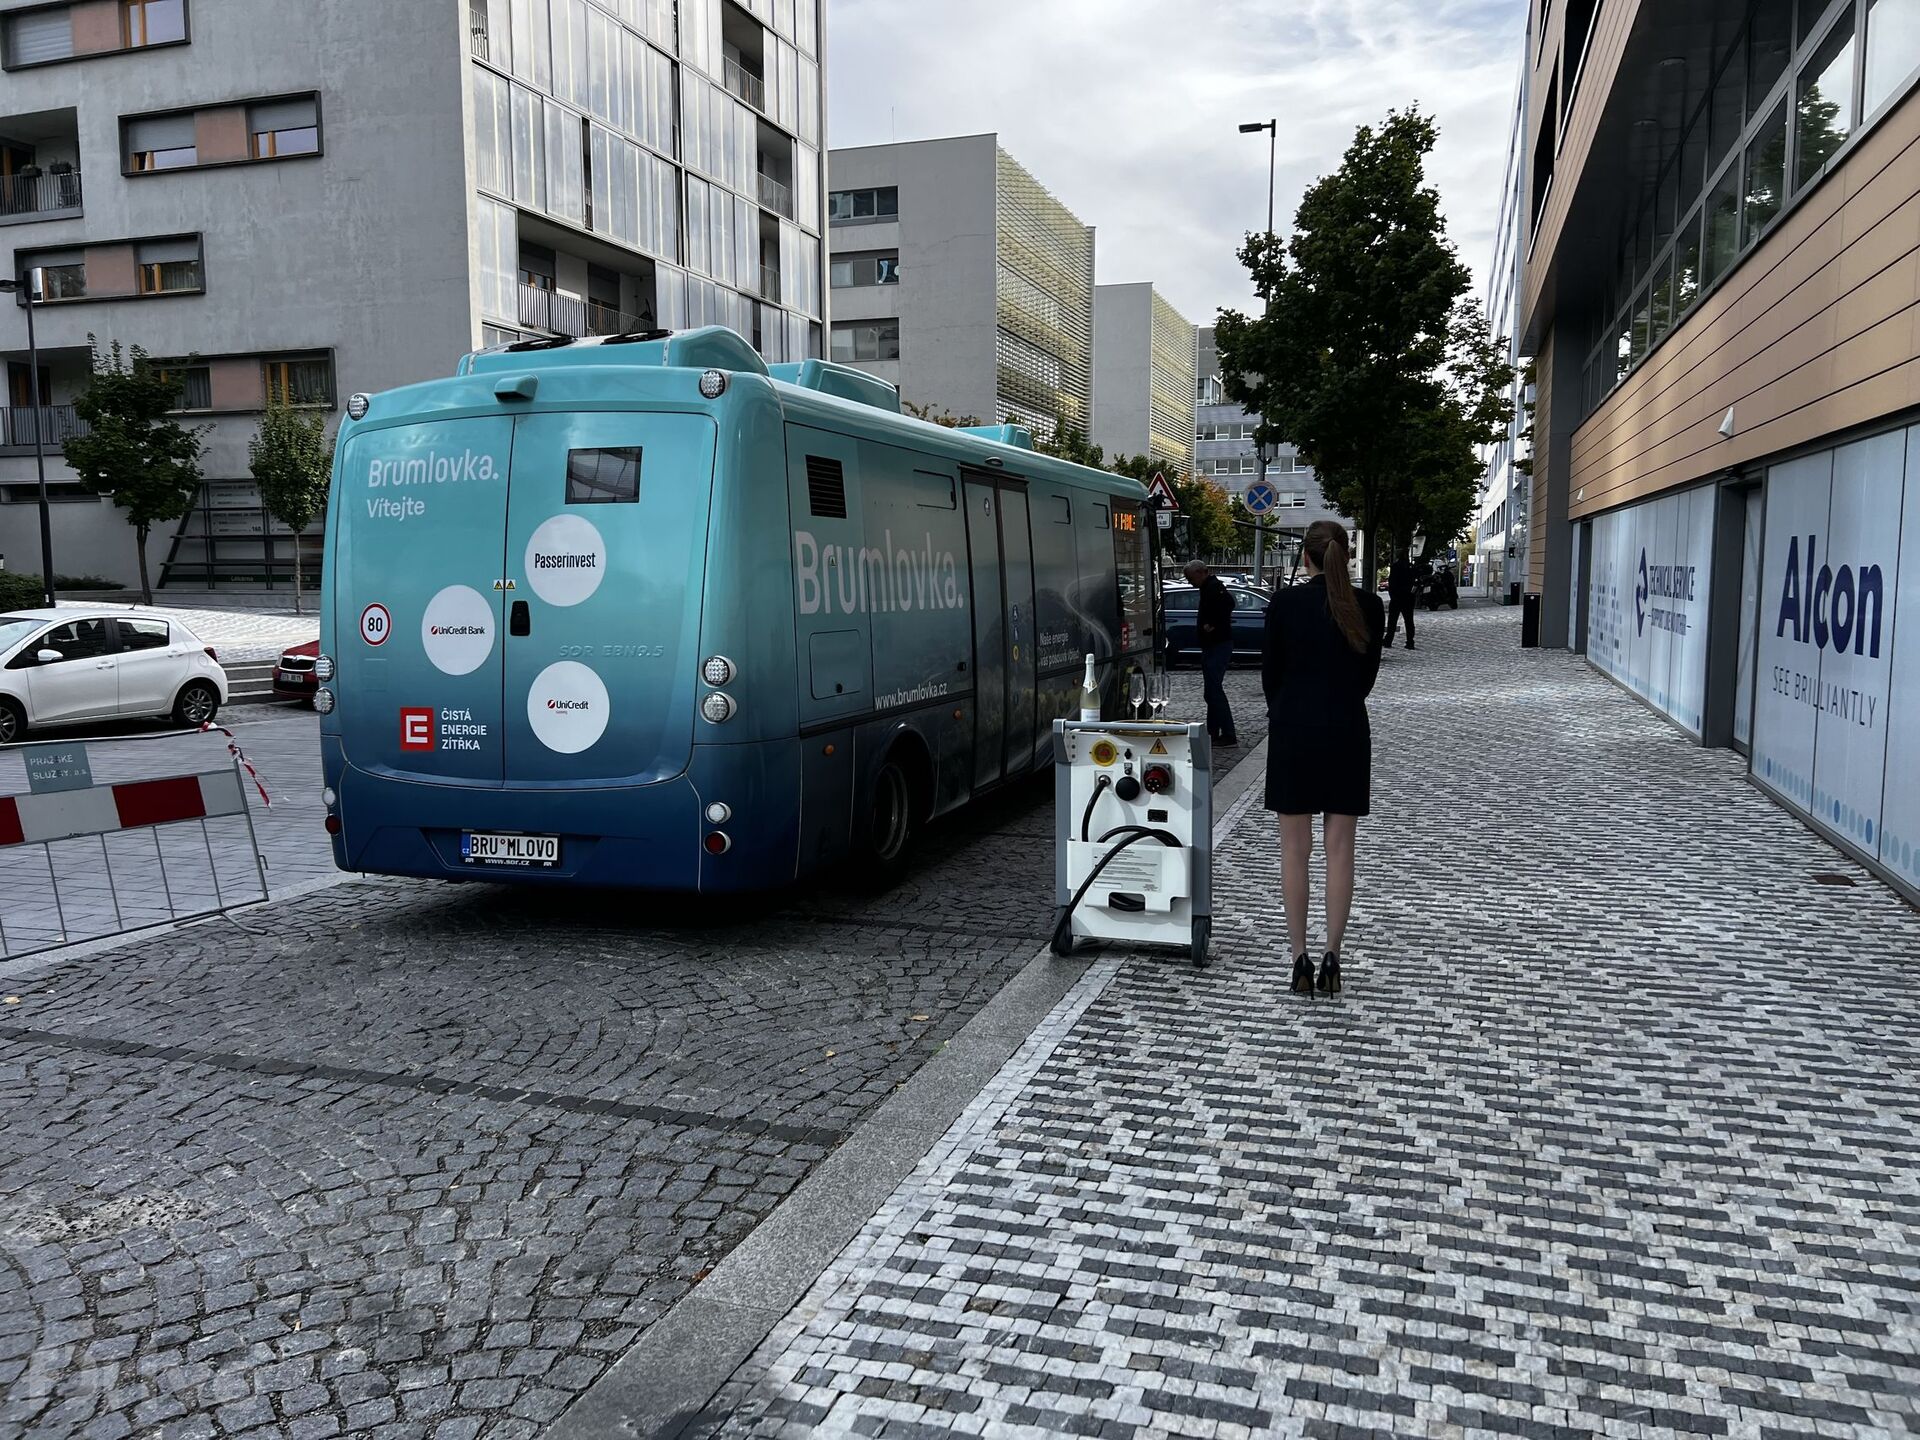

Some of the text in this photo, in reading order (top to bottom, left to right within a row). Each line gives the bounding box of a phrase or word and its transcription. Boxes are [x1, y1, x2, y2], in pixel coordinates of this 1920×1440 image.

[368, 448, 499, 488] Brumlovka.
[367, 496, 425, 521] Vítejte
[534, 552, 596, 569] Passerinvest
[795, 529, 964, 615] Brumlovka.
[1776, 534, 1884, 659] Alcon
[367, 617, 383, 632] 80
[438, 626, 485, 635] UniCredit Bank
[559, 645, 594, 657] SOR
[874, 681, 948, 710] www.brumlovka.cz
[1773, 666, 1877, 728] SEE BRILLIANTLY
[556, 700, 589, 710] UniCredit
[441, 708, 472, 721] ČISTÁ
[441, 725, 487, 736] ENERGIE
[441, 738, 481, 750] ZÍTŘKA
[507, 838, 554, 858] MLOVO
[485, 858, 530, 866] www.sor.cz
